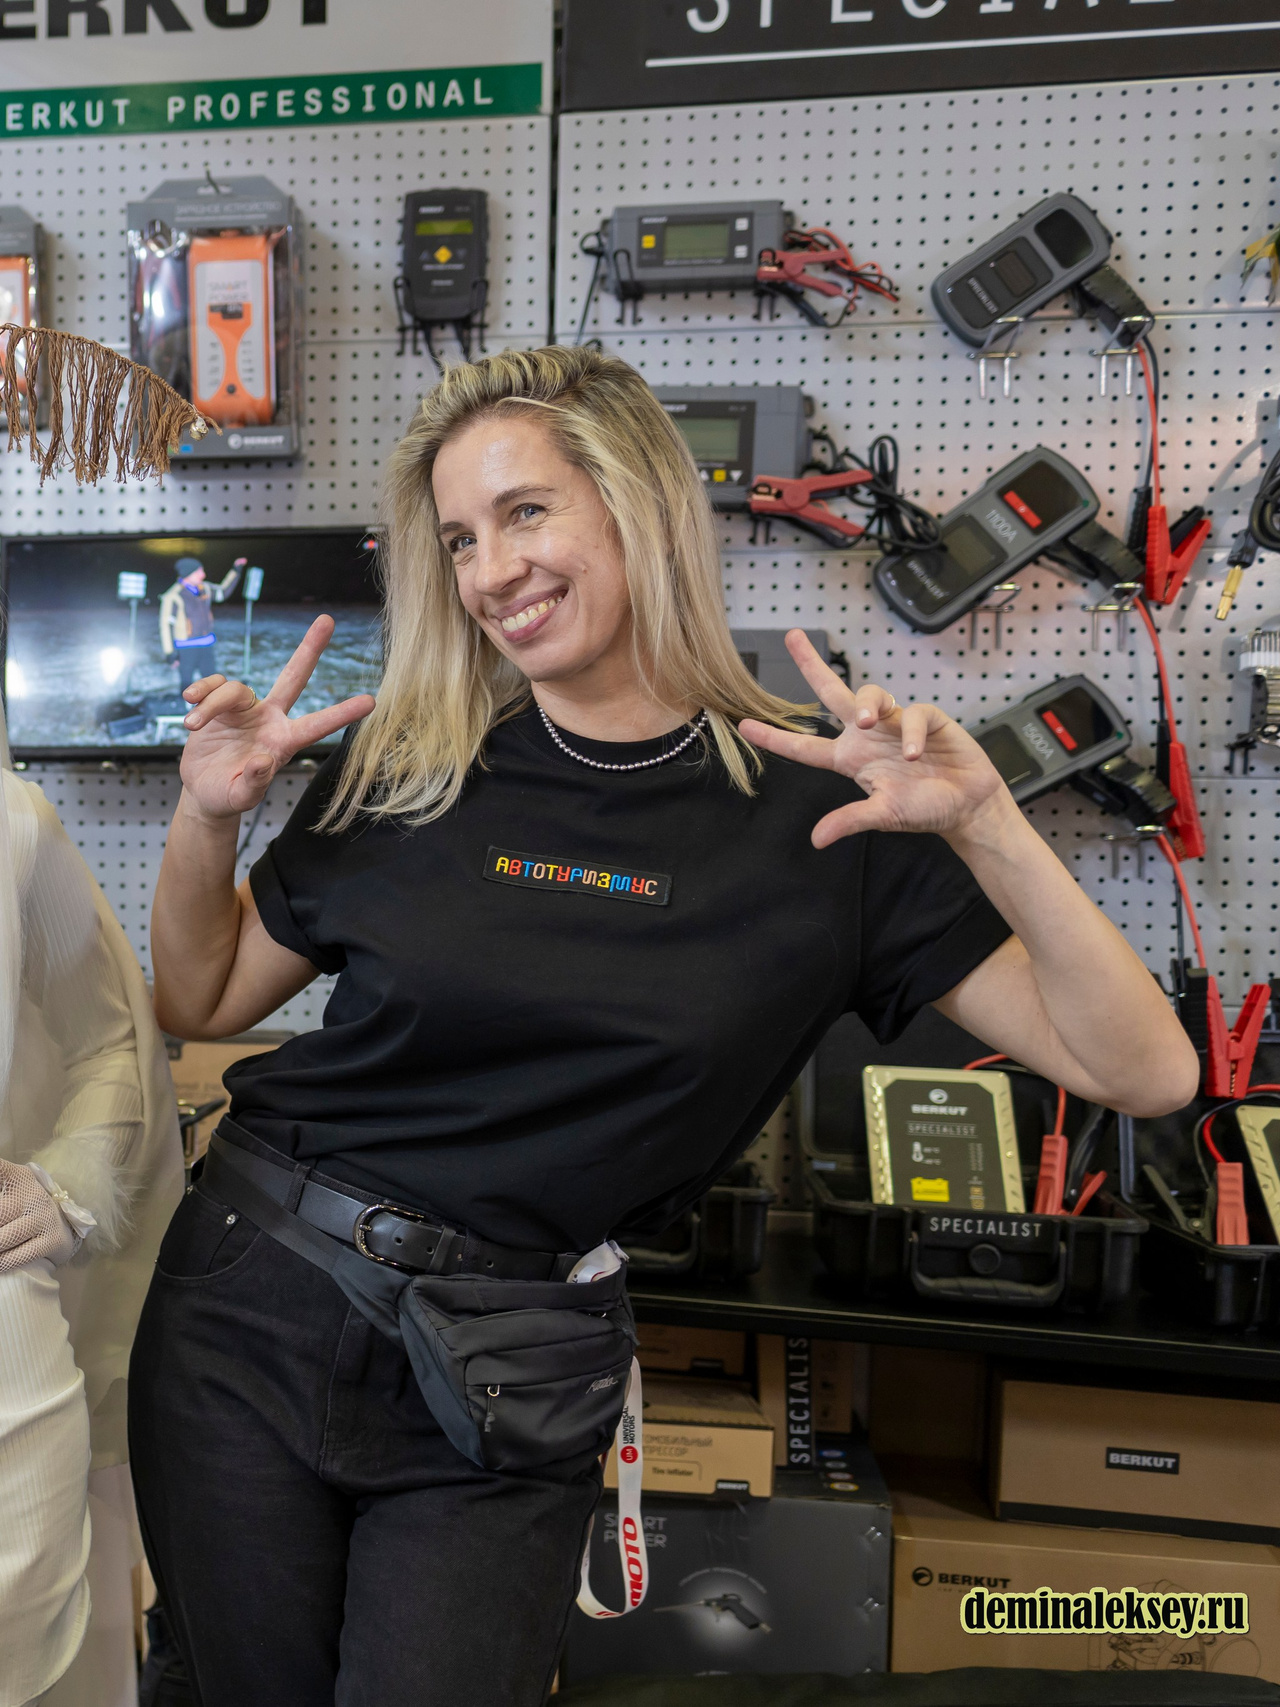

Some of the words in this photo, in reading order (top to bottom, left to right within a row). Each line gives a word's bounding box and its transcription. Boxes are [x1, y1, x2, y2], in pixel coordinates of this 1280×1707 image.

[167, 78, 494, 123] PROFESSIONAL
[984, 508, 1017, 544] 1100A
[1022, 722, 1055, 761] 1500A
[495, 856, 658, 896] АВТОТУРИЗМУС
[910, 1103, 968, 1117] BERKUT
[907, 1122, 976, 1136] SPECIALIST
[929, 1216, 1043, 1238] SPECIALIST
[1109, 1452, 1177, 1470] BERKUT
[717, 1481, 749, 1491] BERKUT
[604, 1512, 668, 1531] SRT
[604, 1529, 668, 1549] PER
[938, 1572, 1011, 1589] BERKUT
